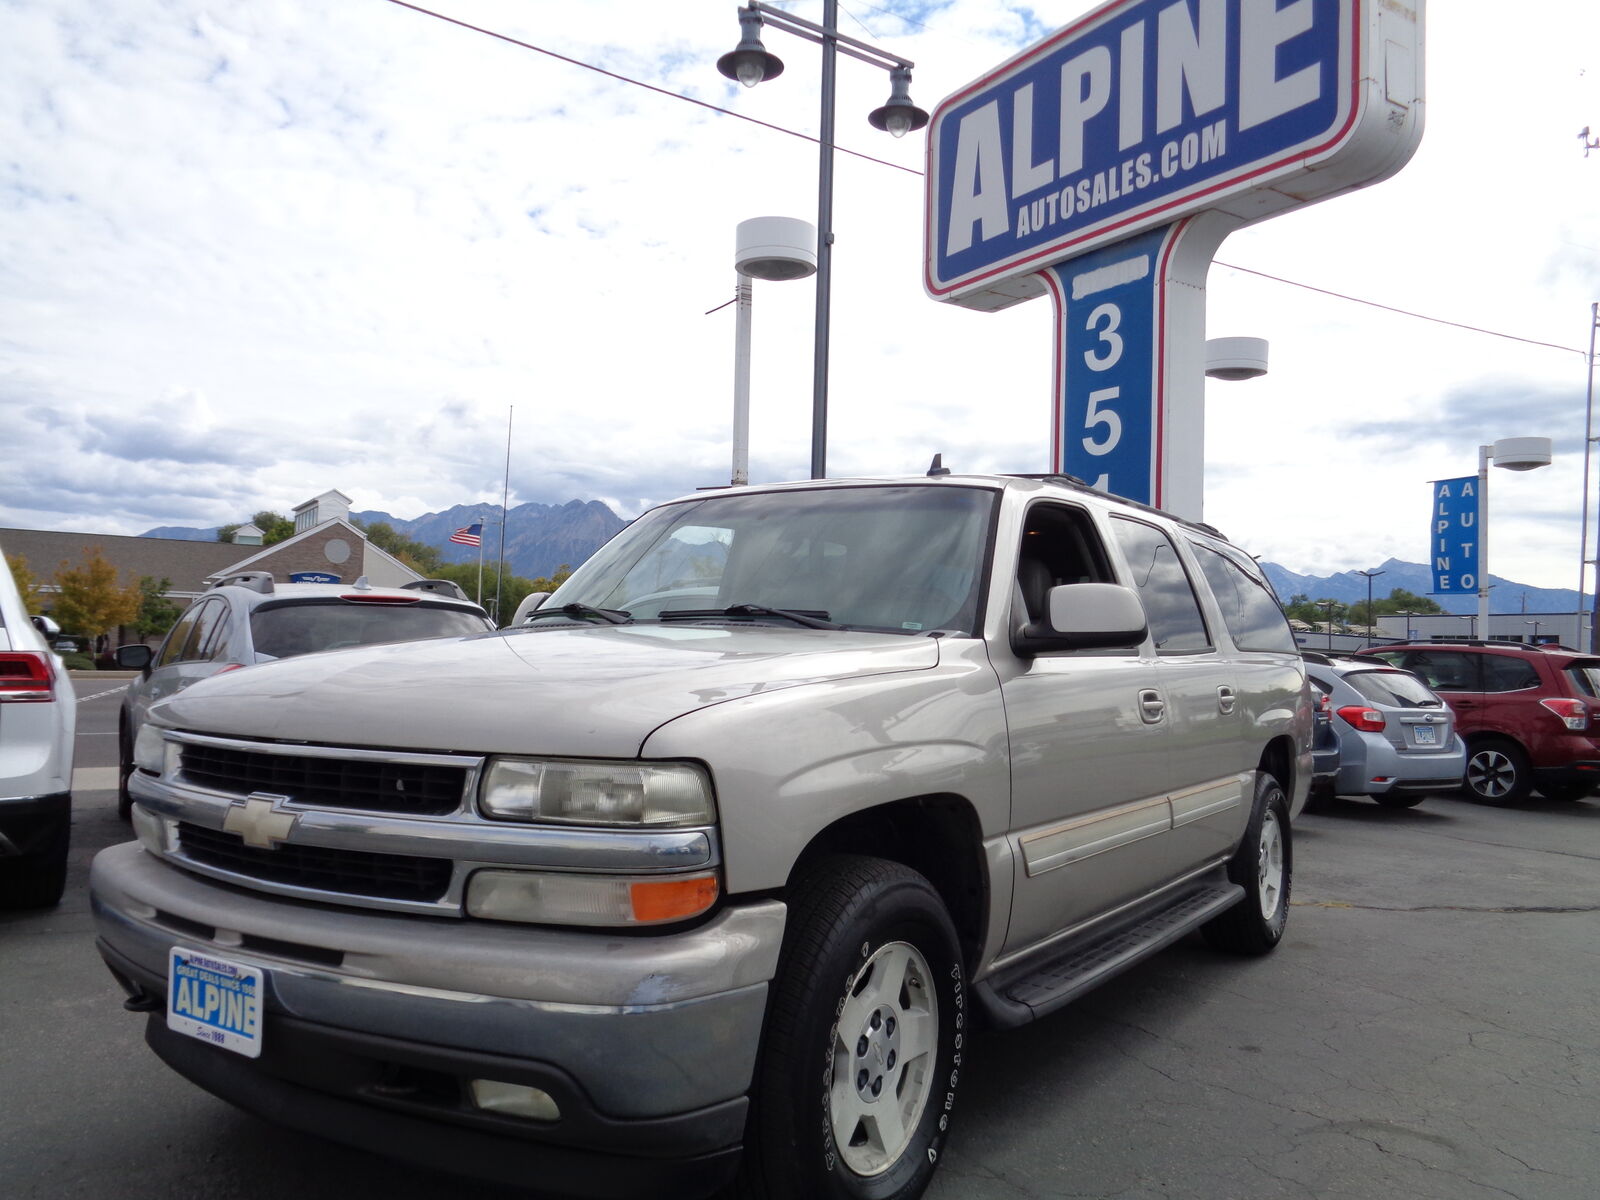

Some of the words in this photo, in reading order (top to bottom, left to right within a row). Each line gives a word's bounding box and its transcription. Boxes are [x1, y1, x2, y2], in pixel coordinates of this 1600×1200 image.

[946, 0, 1320, 256] ALPINE
[1016, 119, 1227, 240] AUTOSALES.COM
[1437, 484, 1450, 590] ALPINE
[1460, 482, 1474, 589] AUTO
[176, 978, 255, 1034] ALPINE
